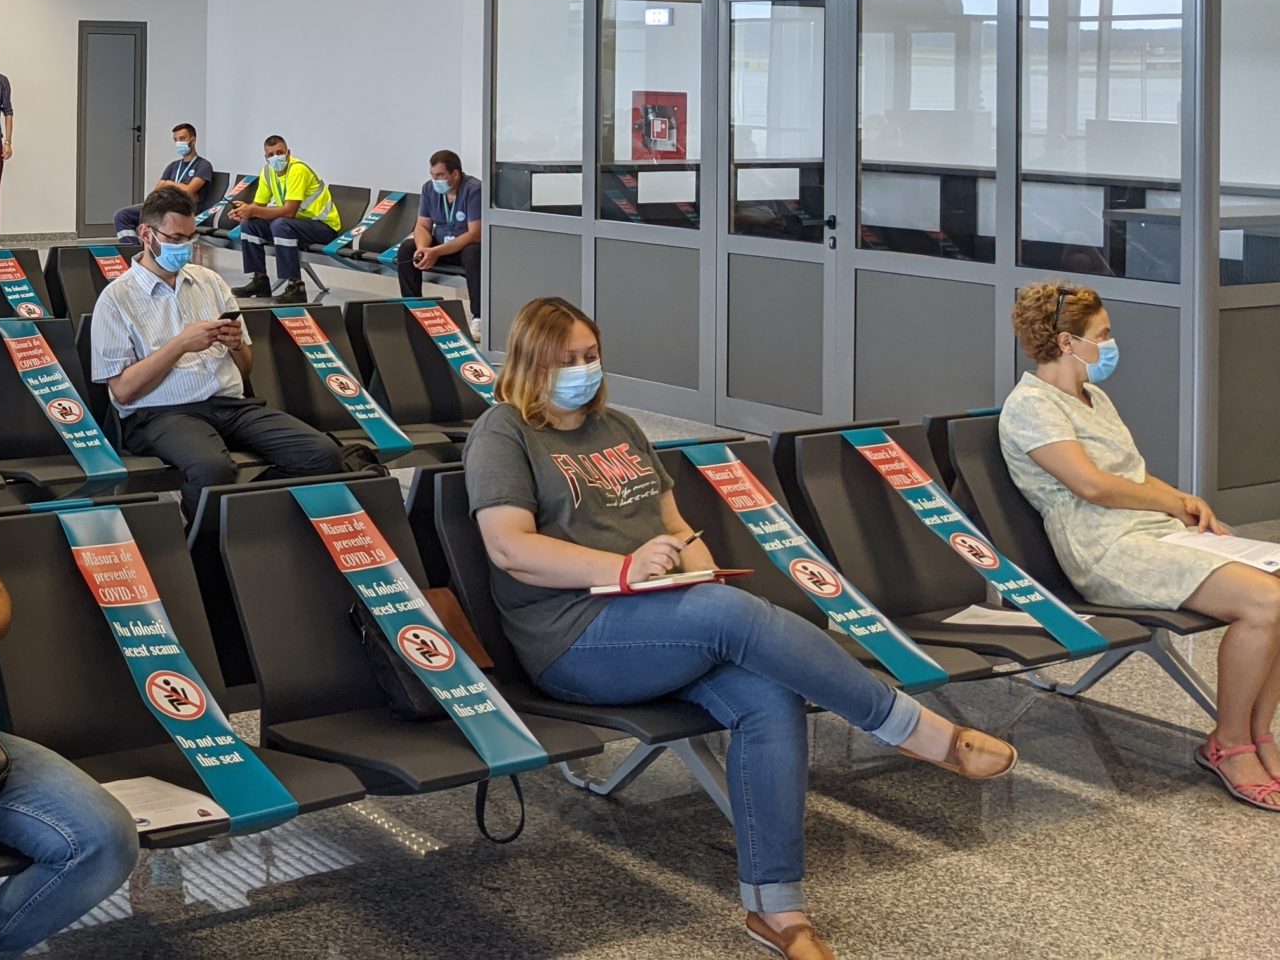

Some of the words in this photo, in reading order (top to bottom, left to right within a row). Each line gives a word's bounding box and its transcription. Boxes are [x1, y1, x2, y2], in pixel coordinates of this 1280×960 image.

[887, 447, 900, 458] de
[731, 465, 745, 477] de
[886, 471, 922, 485] COVID-19
[728, 492, 767, 508] COVID-19
[907, 499, 924, 511] Nu
[922, 514, 944, 525] acest
[939, 511, 963, 523] scaun
[319, 521, 354, 536] Măsură
[352, 518, 367, 531] de
[748, 523, 766, 535] Nu
[333, 533, 374, 552] prevenție
[761, 539, 784, 551] acest
[782, 535, 807, 548] scaun
[81, 551, 120, 567] Măsură
[119, 548, 133, 561] de
[339, 548, 387, 568] COVID-19
[93, 566, 138, 585] prevenție
[357, 584, 378, 598] Nu
[373, 577, 410, 597] folosiți
[990, 580, 1009, 591] Do
[1004, 579, 1021, 590] not
[1015, 578, 1034, 588] use
[98, 584, 149, 602] COVID-19
[1011, 593, 1031, 604] this
[1026, 591, 1046, 602] seat
[370, 602, 399, 617] acest
[396, 598, 426, 612] scaun
[828, 610, 848, 622] Do
[844, 608, 861, 620] not
[857, 607, 876, 617] use
[112, 621, 131, 637] Nu
[129, 619, 167, 638] folosiți
[849, 624, 870, 637] this
[867, 621, 888, 633] seat
[122, 644, 151, 658] acest
[149, 644, 180, 656] scaun
[431, 686, 452, 700] Do
[450, 684, 470, 698] not
[467, 681, 488, 695] use
[452, 703, 477, 718] this
[473, 699, 498, 714] seat
[175, 735, 197, 749] Do
[195, 734, 217, 748] not
[214, 735, 236, 746] use
[195, 752, 221, 767] this
[219, 751, 245, 765] seat
